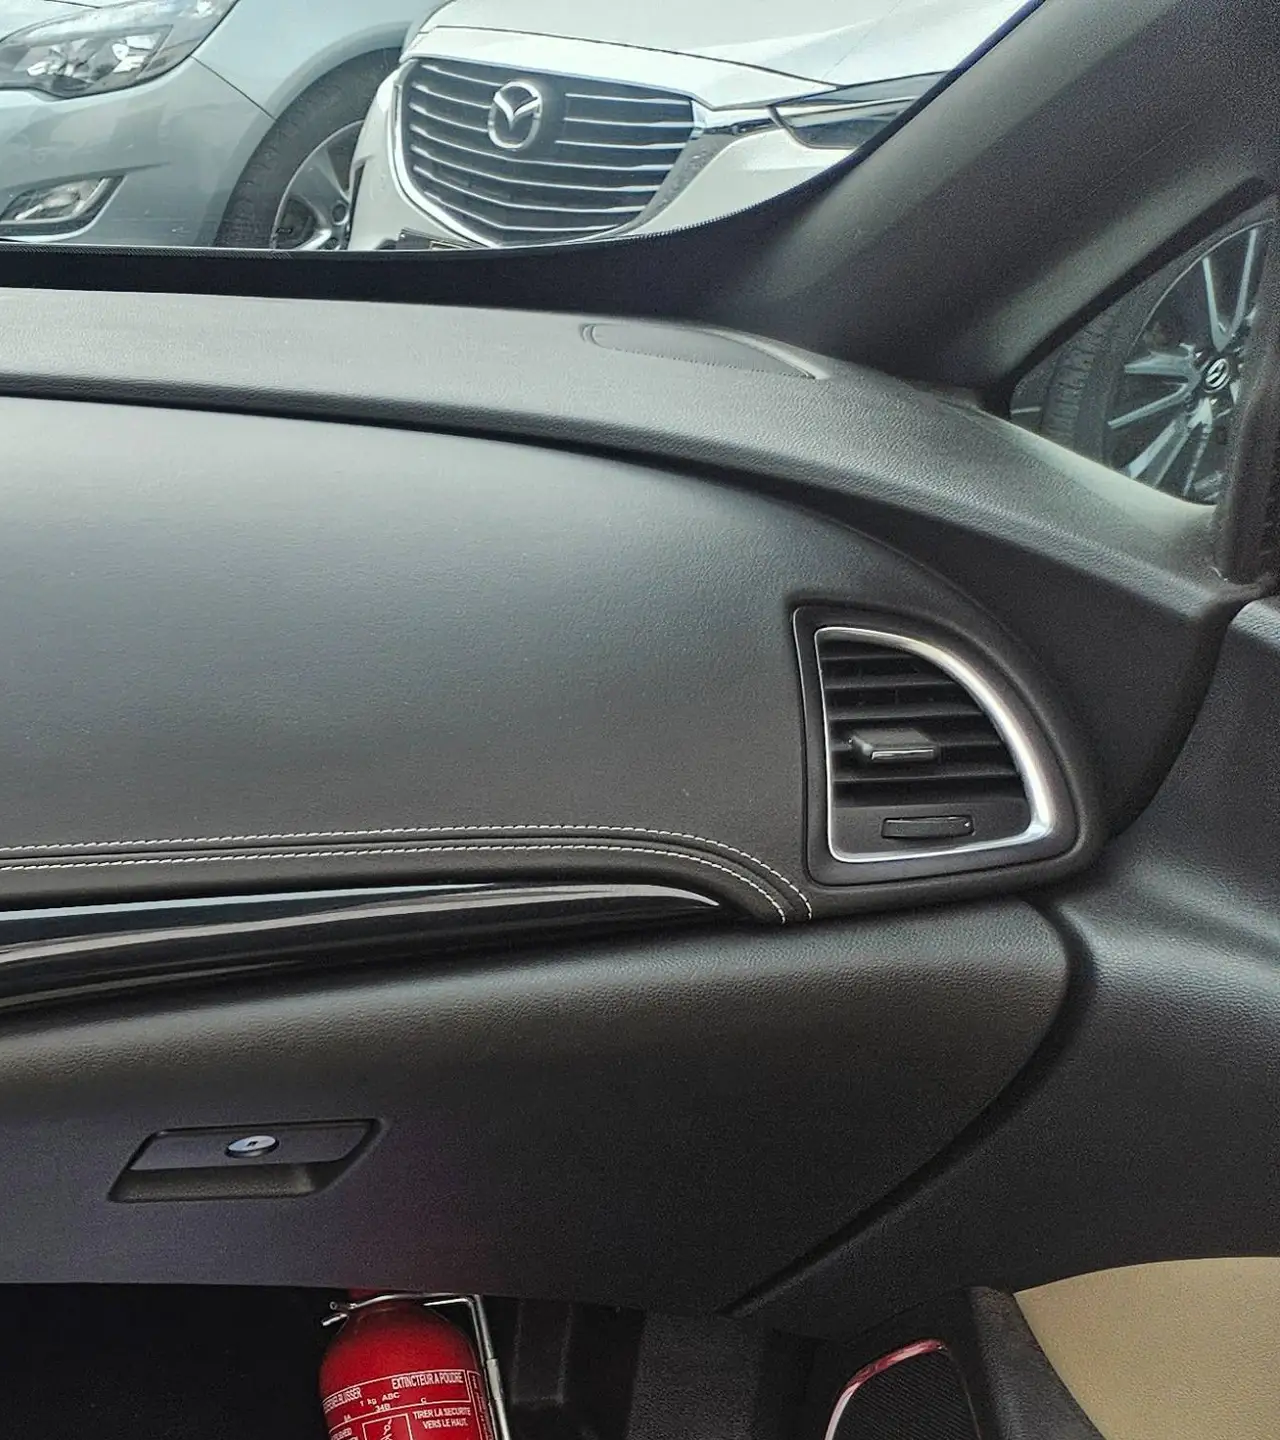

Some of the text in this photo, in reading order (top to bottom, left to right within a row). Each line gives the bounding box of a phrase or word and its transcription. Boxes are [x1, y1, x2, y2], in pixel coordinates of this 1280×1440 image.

[391, 1373, 435, 1390] EXTINCTEUR
[413, 1409, 435, 1420] TIRER
[435, 1408, 445, 1417] LA
[423, 1420, 442, 1429] VERS
[442, 1420, 451, 1428] LE
